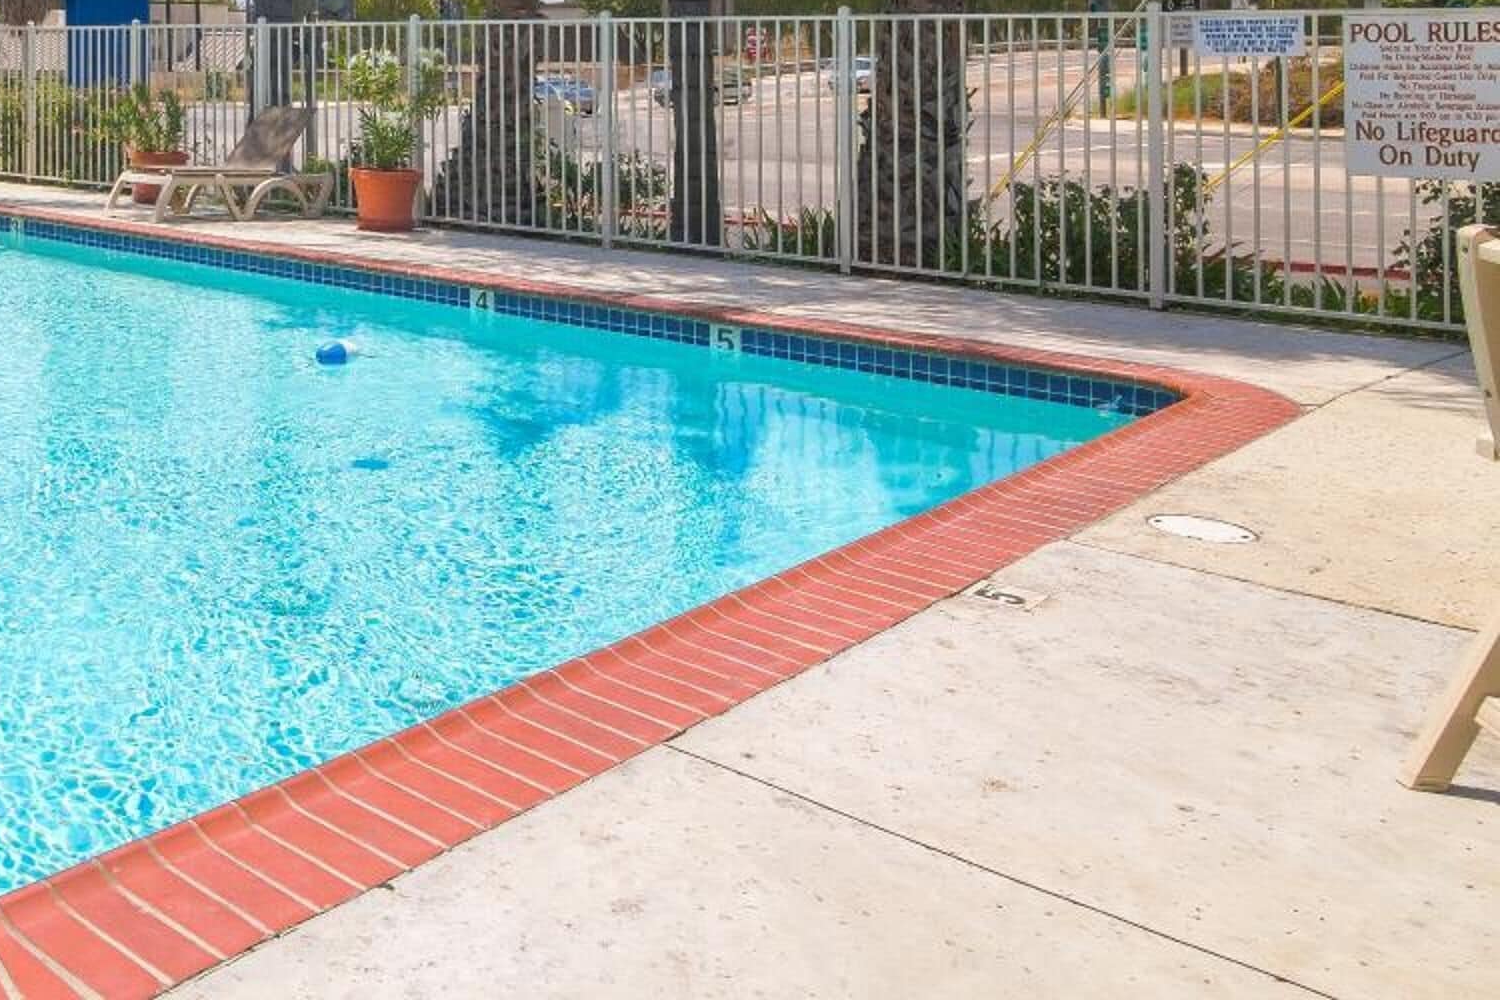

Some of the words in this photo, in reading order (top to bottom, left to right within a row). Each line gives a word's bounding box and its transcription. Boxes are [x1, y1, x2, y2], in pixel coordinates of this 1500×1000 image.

[1350, 22, 1414, 43] POOL
[1428, 21, 1500, 42] RULES
[1355, 120, 1385, 141] No
[1380, 143, 1412, 166] On
[1425, 145, 1479, 172] Duty
[476, 291, 487, 309] 4
[717, 327, 734, 350] 5
